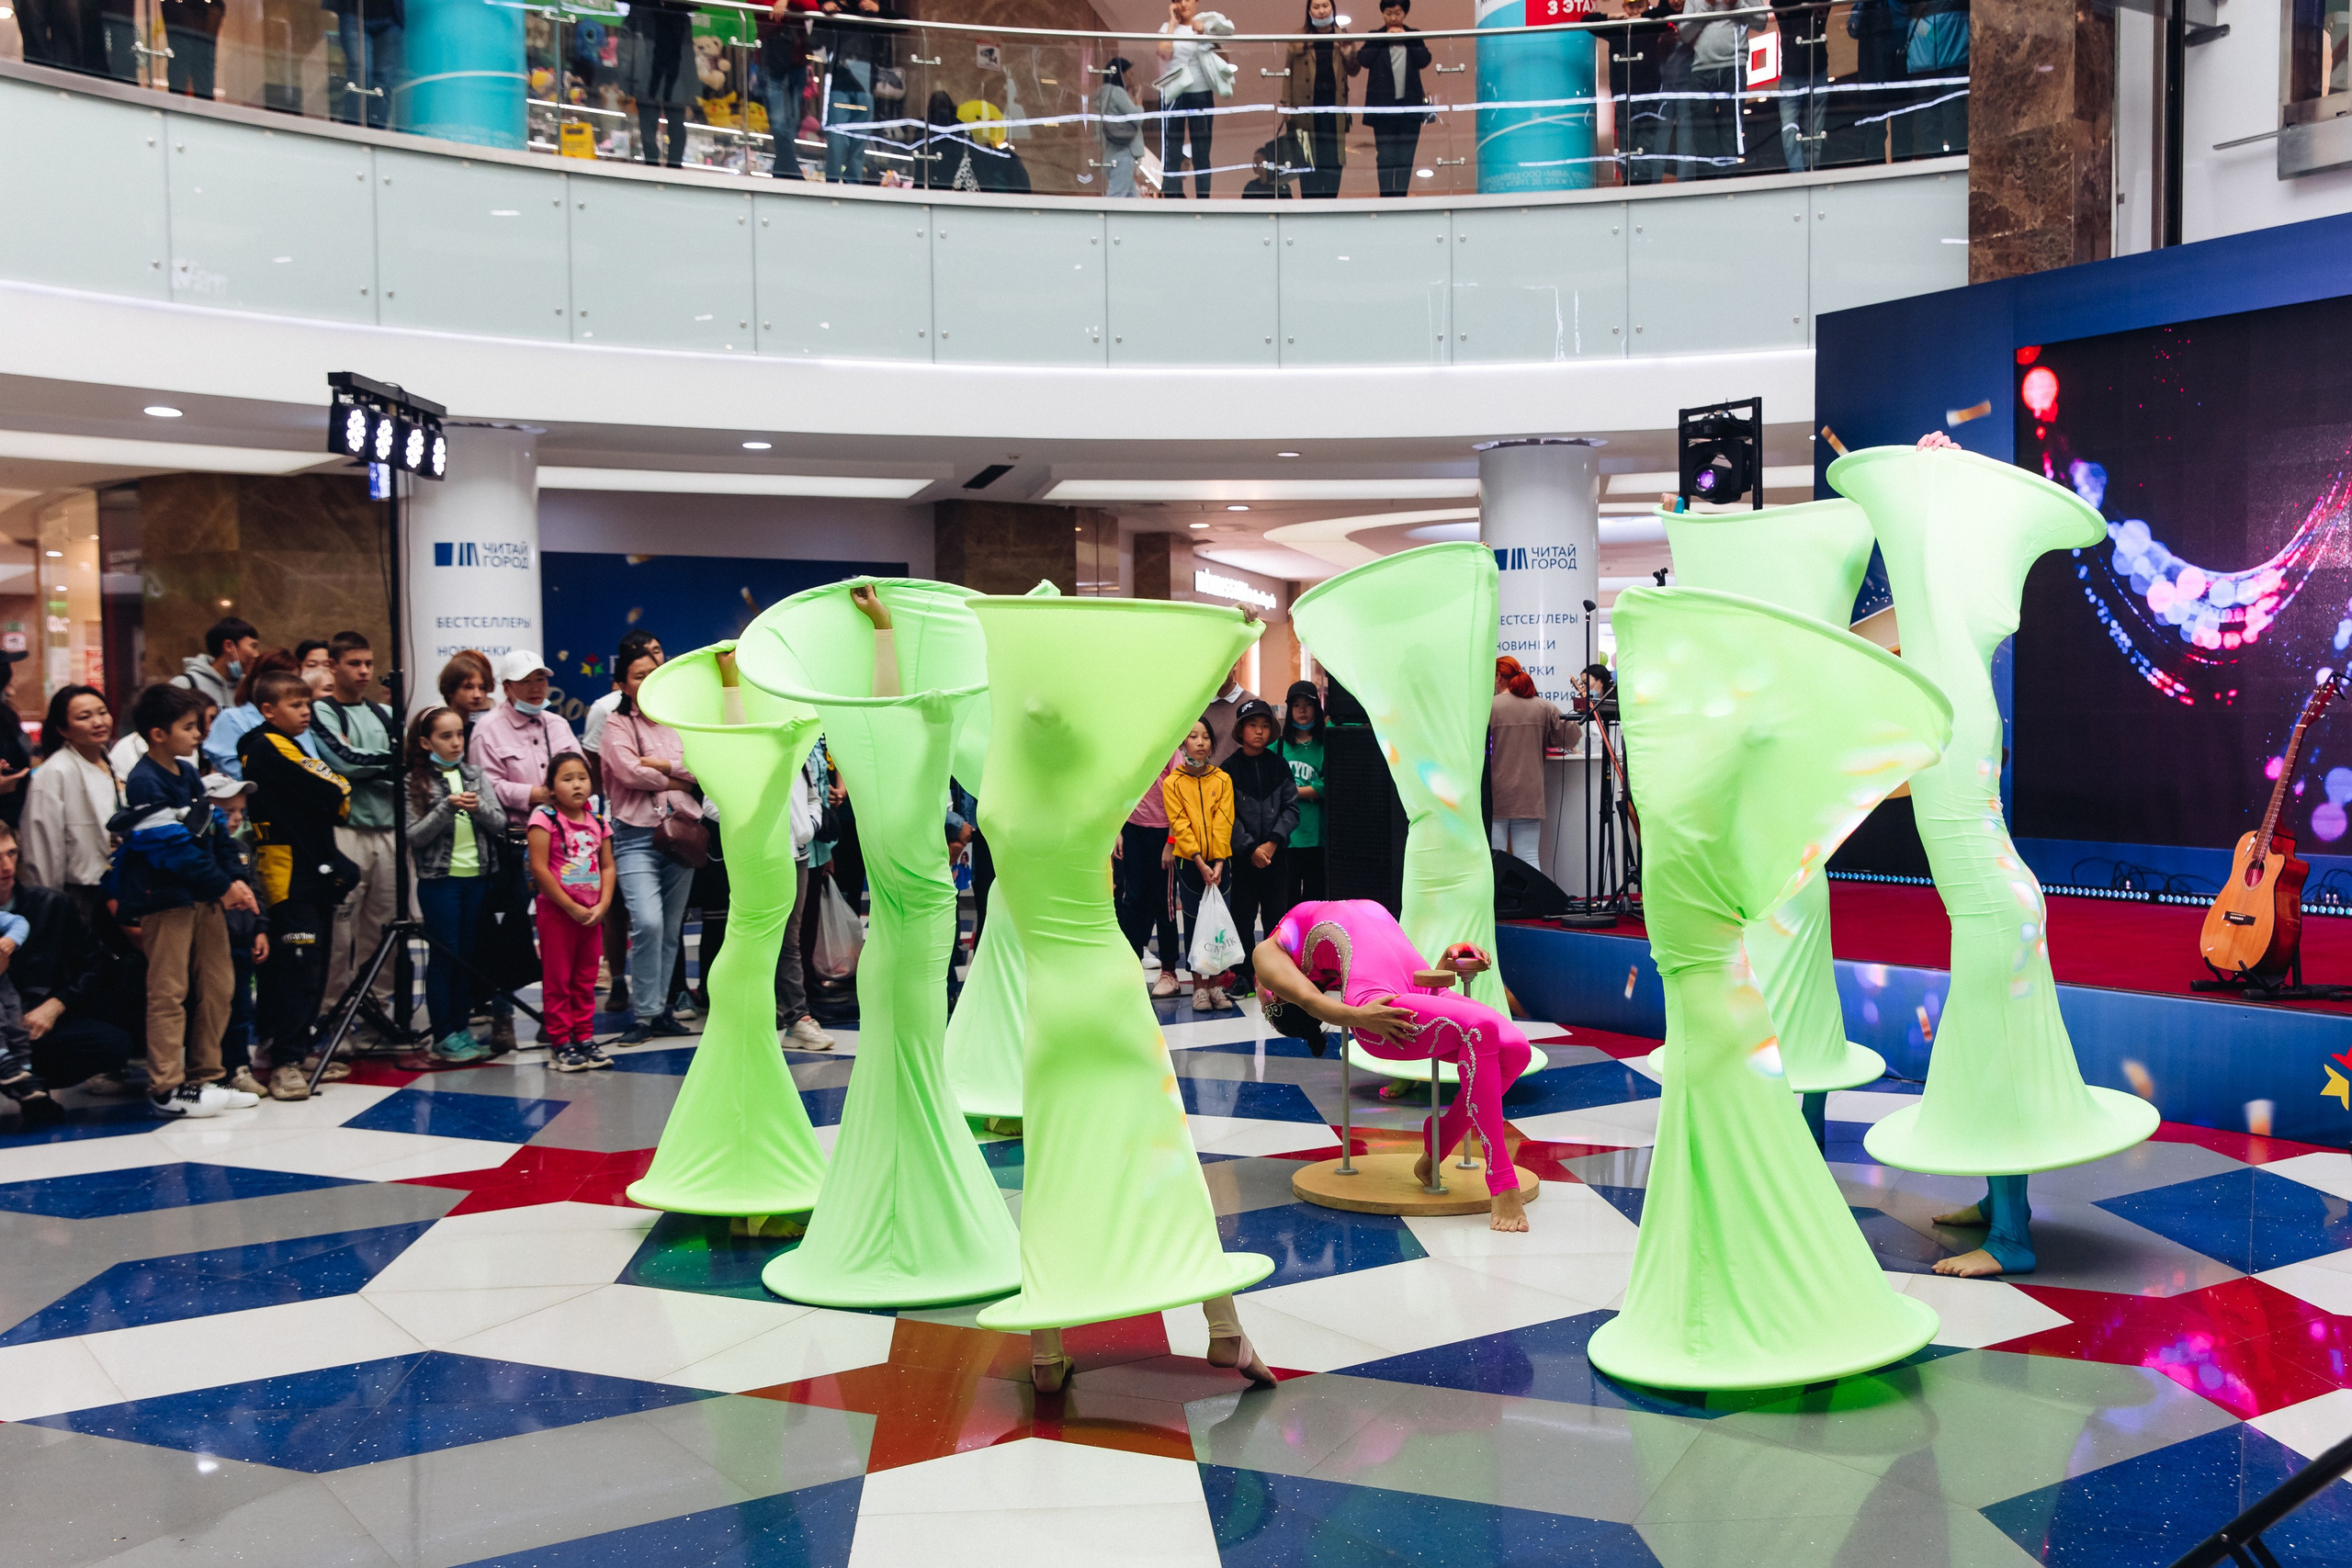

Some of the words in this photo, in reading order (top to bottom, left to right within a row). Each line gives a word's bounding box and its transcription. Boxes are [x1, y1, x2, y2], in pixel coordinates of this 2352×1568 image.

[1547, 0, 1558, 16] 3
[482, 541, 528, 555] ЧИТАЙ
[1531, 544, 1577, 558] ЧИТАЙ
[483, 555, 529, 570] ГОРОД
[1532, 558, 1577, 570] ГОРОД
[436, 616, 532, 628] БЕСТСЕЛЛЕРЫ
[1498, 614, 1578, 626] ЕСТСЕЛЛЕРЫ
[1241, 701, 1254, 713] UFC
